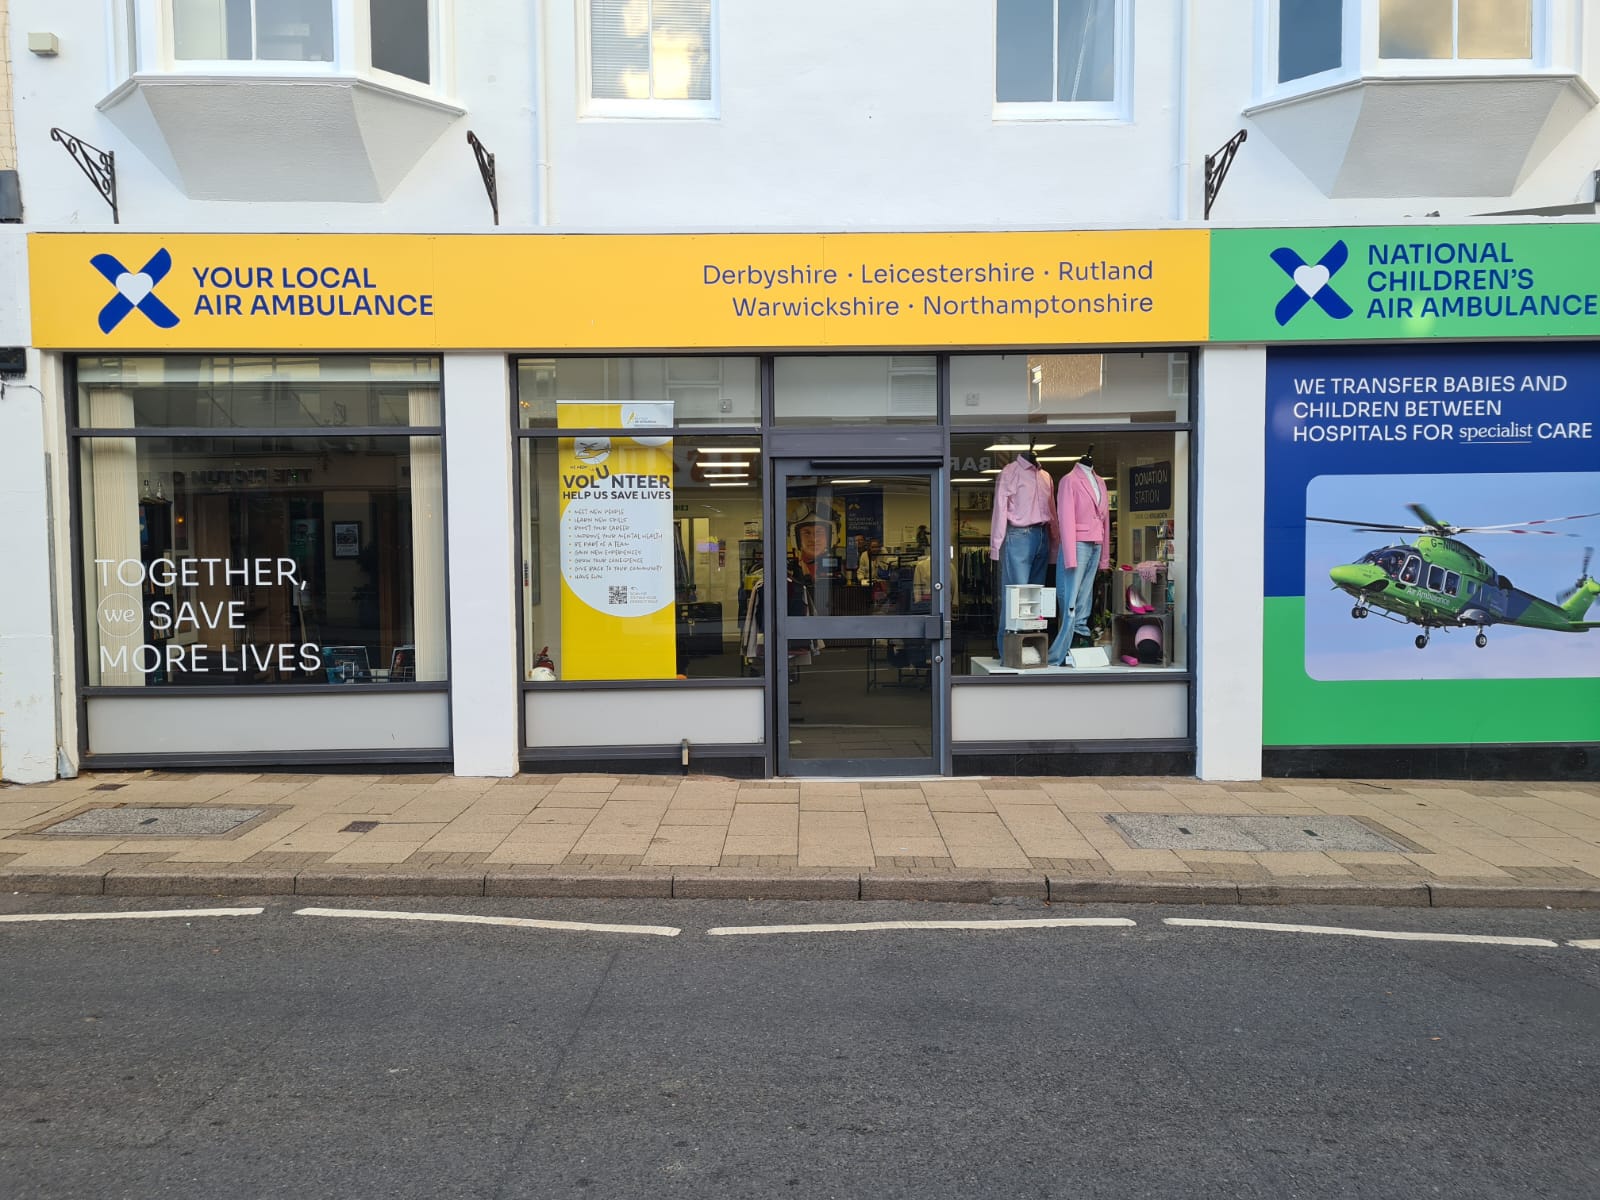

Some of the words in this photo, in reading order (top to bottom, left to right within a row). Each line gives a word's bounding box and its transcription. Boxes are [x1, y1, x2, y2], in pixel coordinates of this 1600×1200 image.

[1368, 242, 1513, 265] NATIONAL
[192, 266, 274, 289] YOUR
[282, 266, 376, 289] LOCAL
[703, 264, 838, 289] Derbyshire
[861, 263, 1034, 284] Leicestershire
[1059, 260, 1153, 281] Rutland
[1367, 268, 1534, 292] CHILDREN’S
[193, 294, 242, 316] AIR
[249, 294, 433, 316] AMBULANCE
[731, 295, 899, 317] Warwickshire
[923, 292, 1153, 318] Northamptonshire
[1366, 297, 1413, 319] AIR
[1420, 294, 1598, 318] AMBULANCE
[1294, 378, 1326, 395] WE
[1331, 376, 1438, 394] TRANSFER
[1443, 375, 1516, 393] BABIES
[1520, 375, 1568, 392] AND
[1293, 401, 1399, 419] CHILDREN
[1405, 399, 1502, 417] BETWEEN
[1293, 424, 1407, 442] HOSPITALS
[1413, 424, 1453, 440] FOR
[1459, 421, 1533, 441] specialist
[1537, 422, 1592, 439] CARE
[563, 465, 671, 489] VOLUNTEER
[1135, 468, 1168, 486] DONATION
[563, 491, 591, 500] HELP
[593, 491, 608, 500] US
[611, 491, 639, 500] SAVE
[641, 491, 671, 500] LIVES
[1135, 489, 1160, 504] STATION
[642, 532, 663, 540] HEALTH
[94, 557, 307, 591] TOGETHER,
[1416, 590, 1450, 605] Ambulance
[104, 606, 136, 623] we
[149, 600, 246, 630] SAVE
[100, 643, 208, 674] MORE
[222, 642, 321, 672] LIVES
